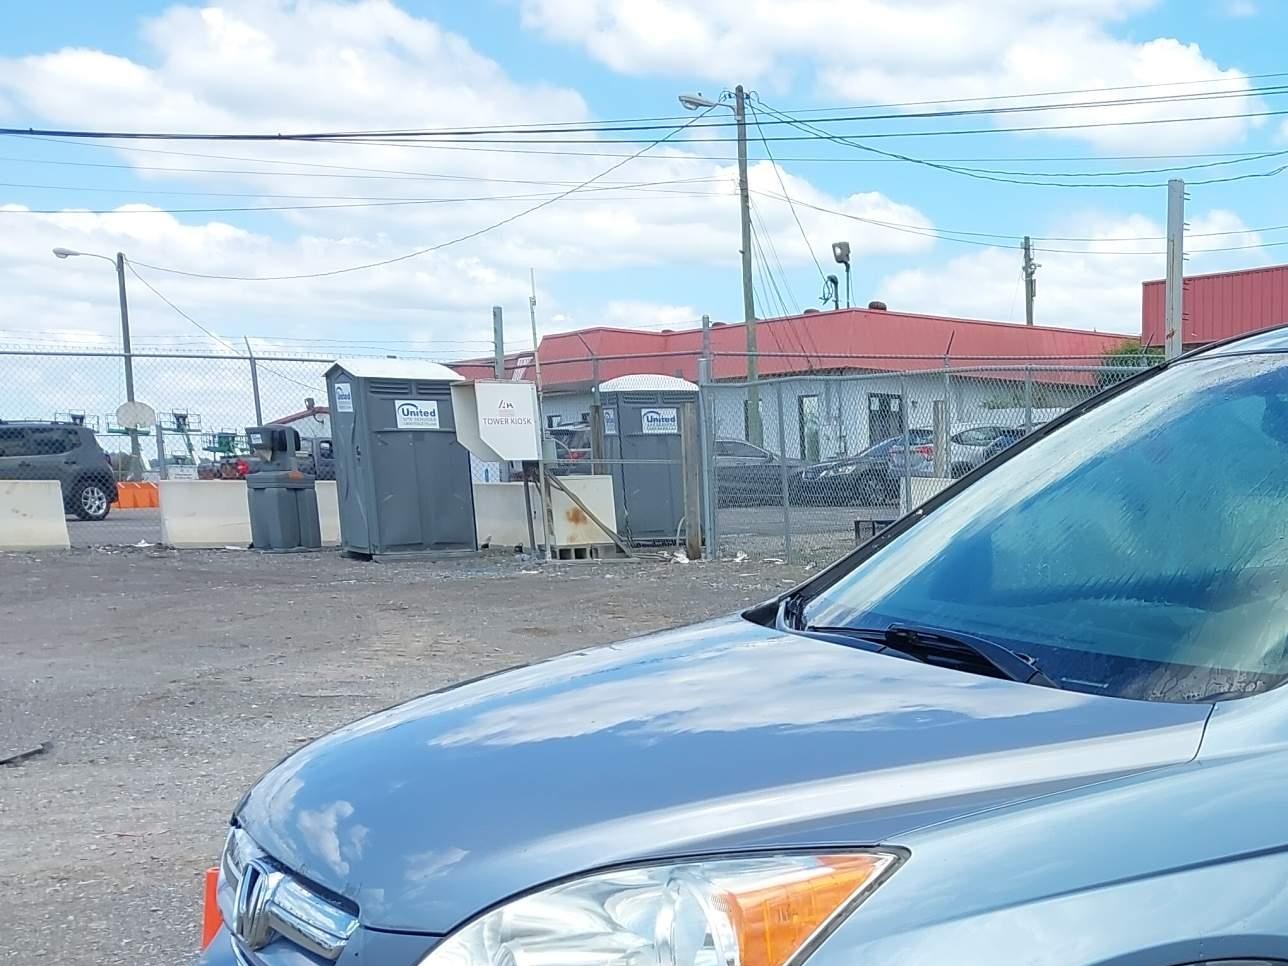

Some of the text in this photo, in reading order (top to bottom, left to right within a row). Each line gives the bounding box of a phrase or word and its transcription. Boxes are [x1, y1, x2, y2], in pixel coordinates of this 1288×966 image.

[401, 407, 436, 417] United
[482, 417, 532, 425] TOWER KIOSK
